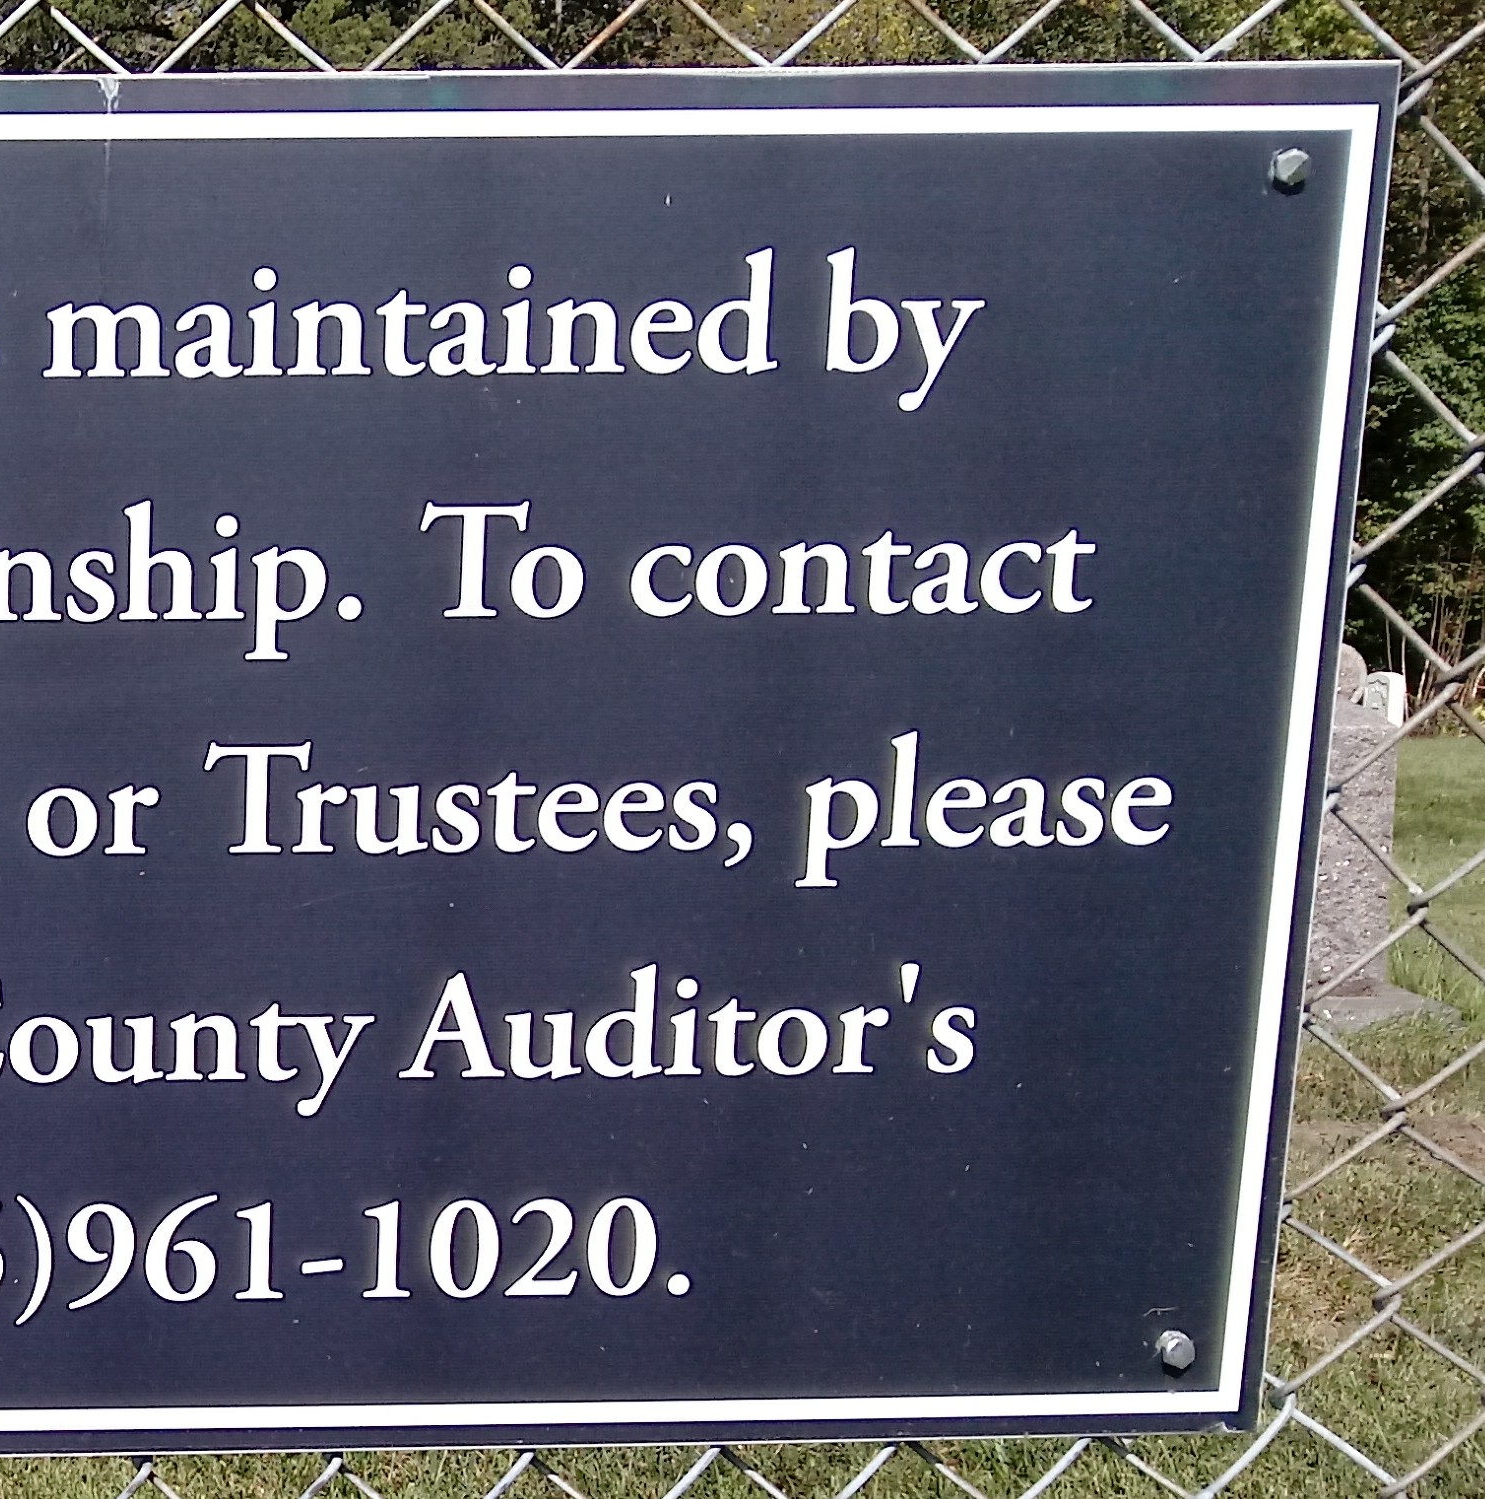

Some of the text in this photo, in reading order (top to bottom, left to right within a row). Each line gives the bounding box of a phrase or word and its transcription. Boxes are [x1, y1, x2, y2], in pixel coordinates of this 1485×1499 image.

[43, 248, 777, 378] maintained
[827, 247, 985, 411] by
[421, 501, 583, 618] To
[631, 530, 1095, 616] contact
[28, 786, 158, 856] or
[204, 742, 751, 866] Trustees,
[796, 731, 1171, 887] please
[399, 964, 974, 1079] Auditor's
